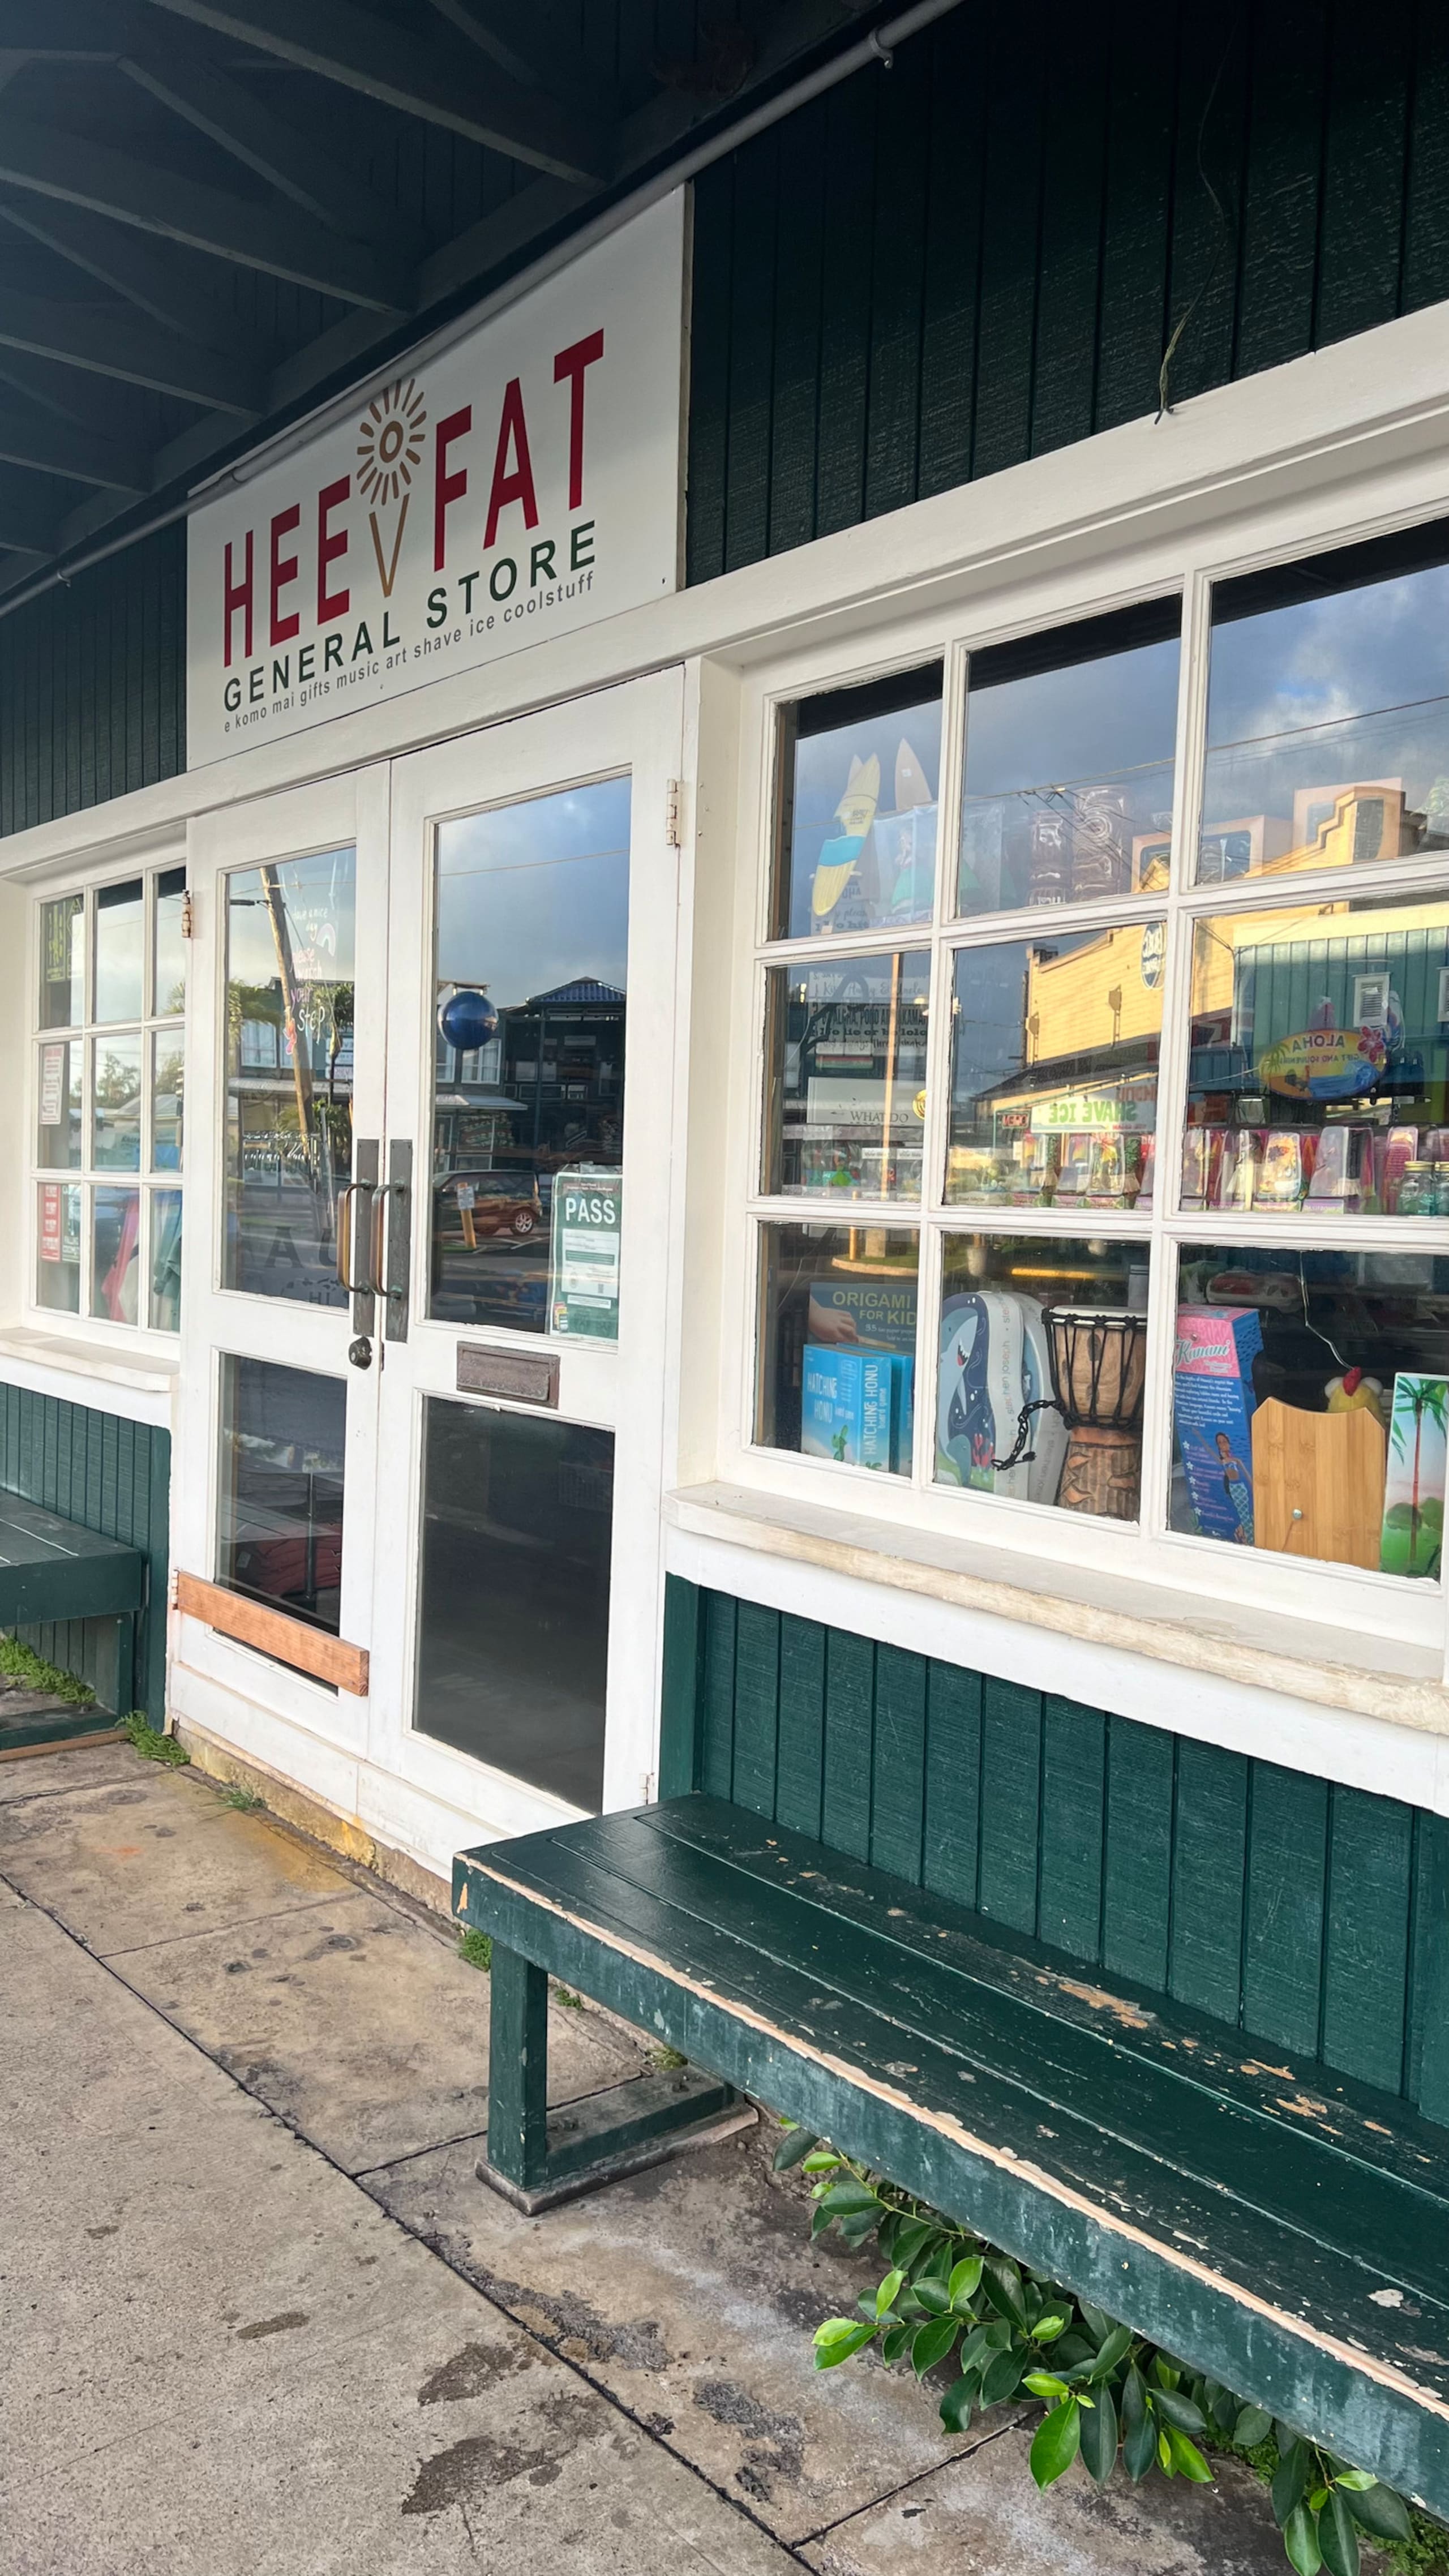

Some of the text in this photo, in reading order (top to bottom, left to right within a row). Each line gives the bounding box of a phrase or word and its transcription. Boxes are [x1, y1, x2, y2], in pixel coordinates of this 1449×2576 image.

[224, 328, 604, 668] HEE FAT
[224, 520, 595, 711] GENERAL STORE
[225, 571, 594, 732] e komo mai gifts music art shave ice coolstuff
[290, 987, 312, 1014] your
[566, 1197, 616, 1224] PASS
[833, 1291, 910, 1309] ORIGAMI
[860, 1310, 883, 1319] FOR
[1176, 1339, 1231, 1366] Kanani
[807, 1373, 838, 1399] HATCHING
[814, 1399, 833, 1424] HONU
[863, 1364, 878, 1455] HATCHING HONU
